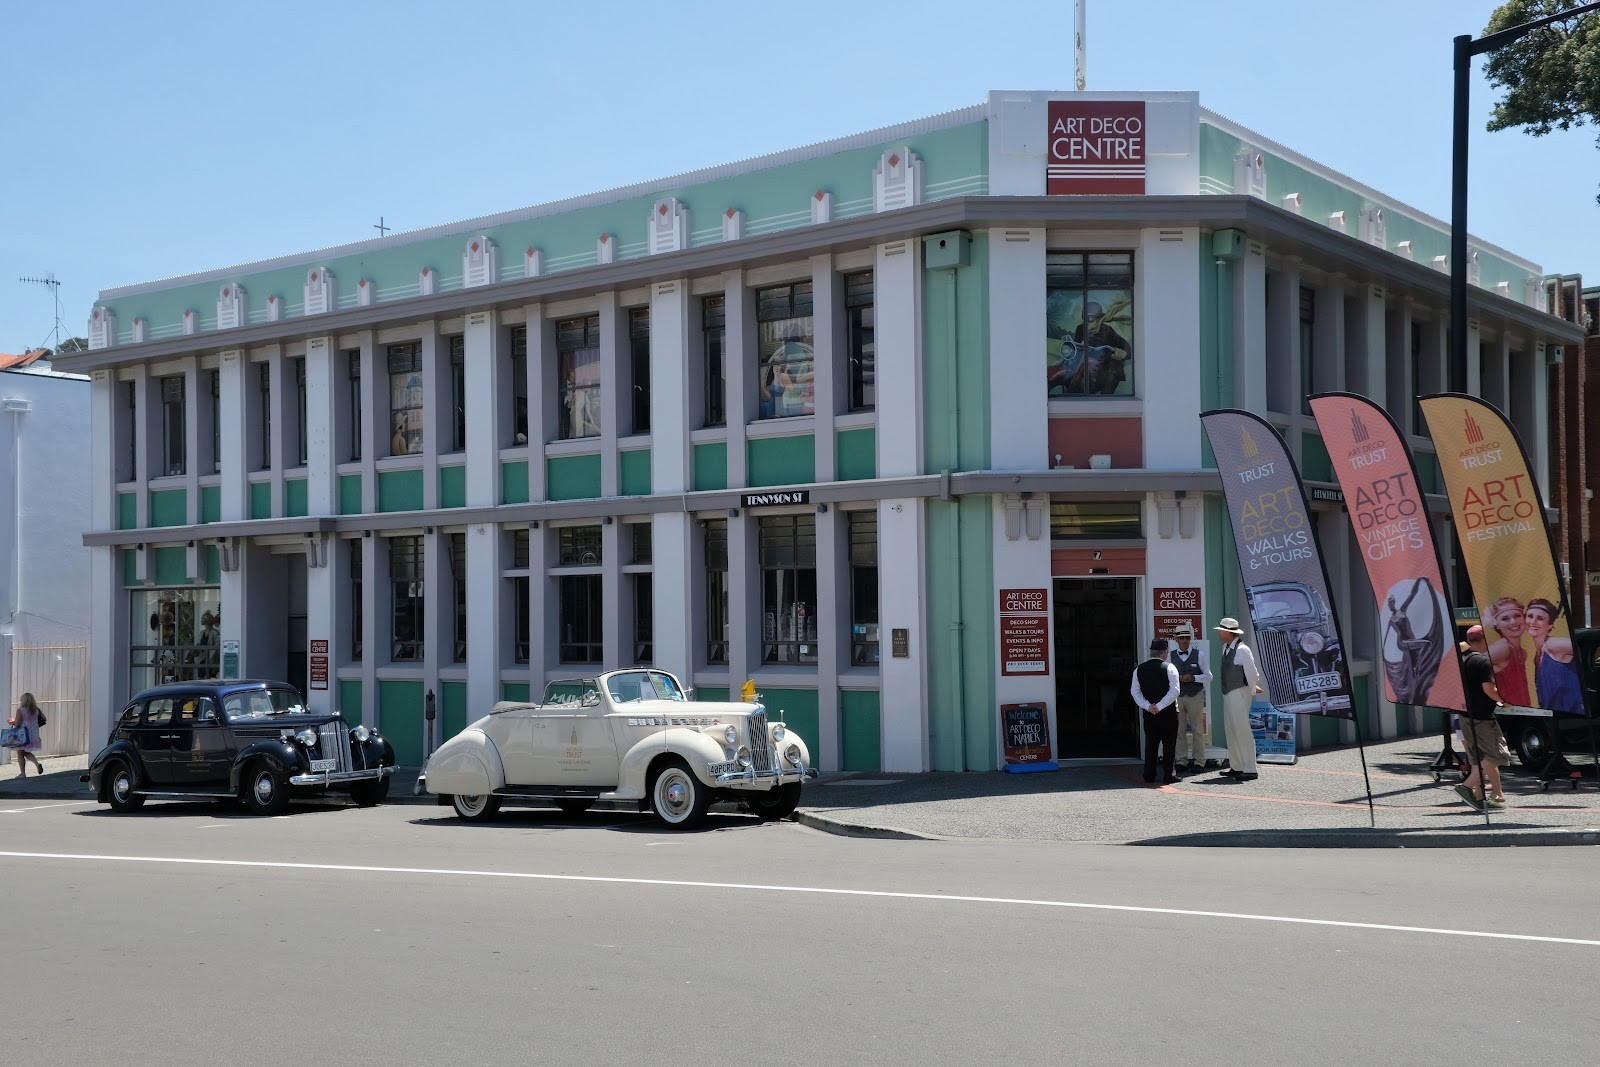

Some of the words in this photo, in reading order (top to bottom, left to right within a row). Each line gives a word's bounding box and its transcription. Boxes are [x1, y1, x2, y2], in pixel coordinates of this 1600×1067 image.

[1052, 117, 1085, 134] ART
[1090, 117, 1142, 134] DECO
[1052, 137, 1141, 159] CENTRE
[1348, 447, 1361, 457] ART
[1363, 440, 1385, 453] DECO
[1349, 448, 1387, 470] TRUST
[1460, 448, 1474, 458] ART
[1476, 441, 1500, 454] DECO
[1460, 449, 1502, 470] TRUST
[1238, 463, 1275, 484] TRUST
[746, 493, 791, 506] TENNYSON
[792, 492, 804, 503] ST
[1356, 472, 1408, 511] ART
[1463, 474, 1525, 511] ART
[1241, 485, 1295, 523] ART
[1358, 498, 1417, 530] DECO
[1464, 500, 1533, 529] DECO
[1242, 511, 1304, 541] DECO
[1362, 517, 1420, 544] VINTAGE
[1467, 520, 1536, 543] FESTIVAL
[1245, 530, 1308, 556] WALKS
[1367, 531, 1424, 561] GIFTS
[1250, 558, 1261, 570] &
[1262, 546, 1313, 566] TOURS
[1006, 592, 1020, 600] ART
[1021, 592, 1043, 600] DECO
[1006, 600, 1043, 610] CENTRE
[1160, 591, 1174, 599] ART
[1174, 591, 1196, 599] DECO
[1160, 599, 1196, 609] CENTRE
[1299, 675, 1339, 691] HZS285
